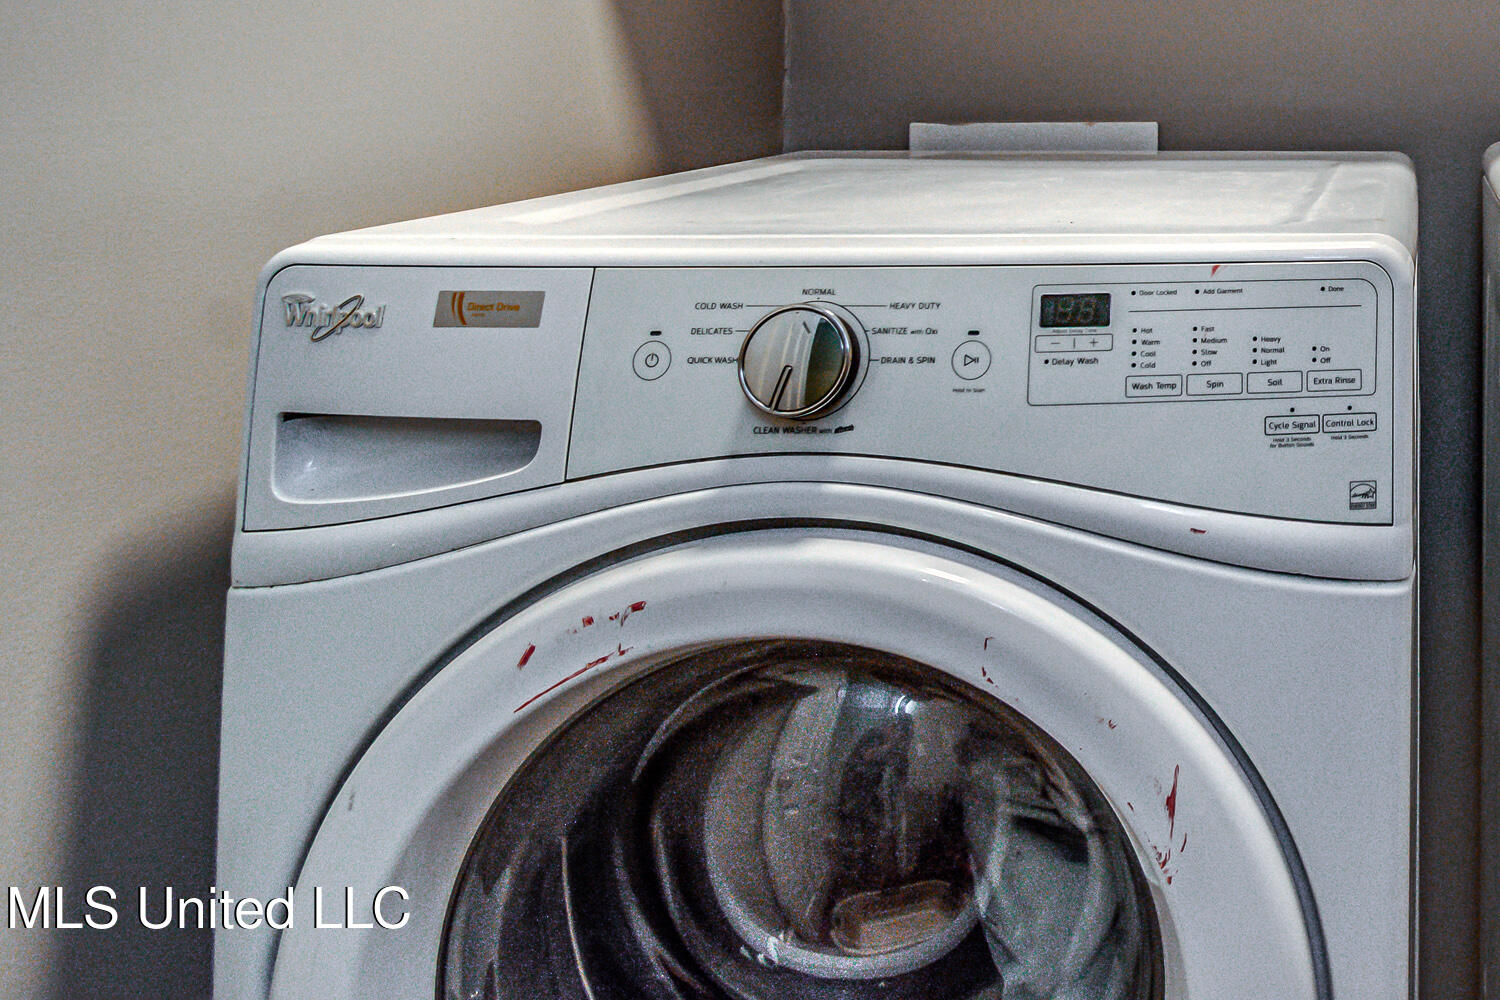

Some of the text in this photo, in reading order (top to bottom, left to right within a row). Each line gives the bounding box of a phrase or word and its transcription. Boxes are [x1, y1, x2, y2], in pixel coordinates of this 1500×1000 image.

[801, 288, 837, 296] NORMAL
[466, 301, 521, 312] Direct Drive
[694, 302, 744, 310] COLD WASH
[889, 302, 941, 310] HEAVY DUTY
[281, 294, 387, 341] Whirlpool
[690, 327, 733, 335] DELICATES
[871, 327, 909, 335] SANITIZE
[686, 356, 739, 365] QUICK WASH
[880, 356, 936, 364] DRAIN & SPIN
[1051, 357, 1099, 367] Delay Wash
[1260, 359, 1277, 367] Light
[1206, 380, 1224, 390] Spin
[1267, 378, 1283, 386] Soil
[1313, 376, 1356, 385] Extra Rinse
[1131, 381, 1177, 391] Wash Temp
[1268, 420, 1317, 431] Cycle Signal
[1325, 418, 1375, 428] Control Lock
[752, 426, 780, 434] CLEAN
[782, 425, 817, 434] WASHER
